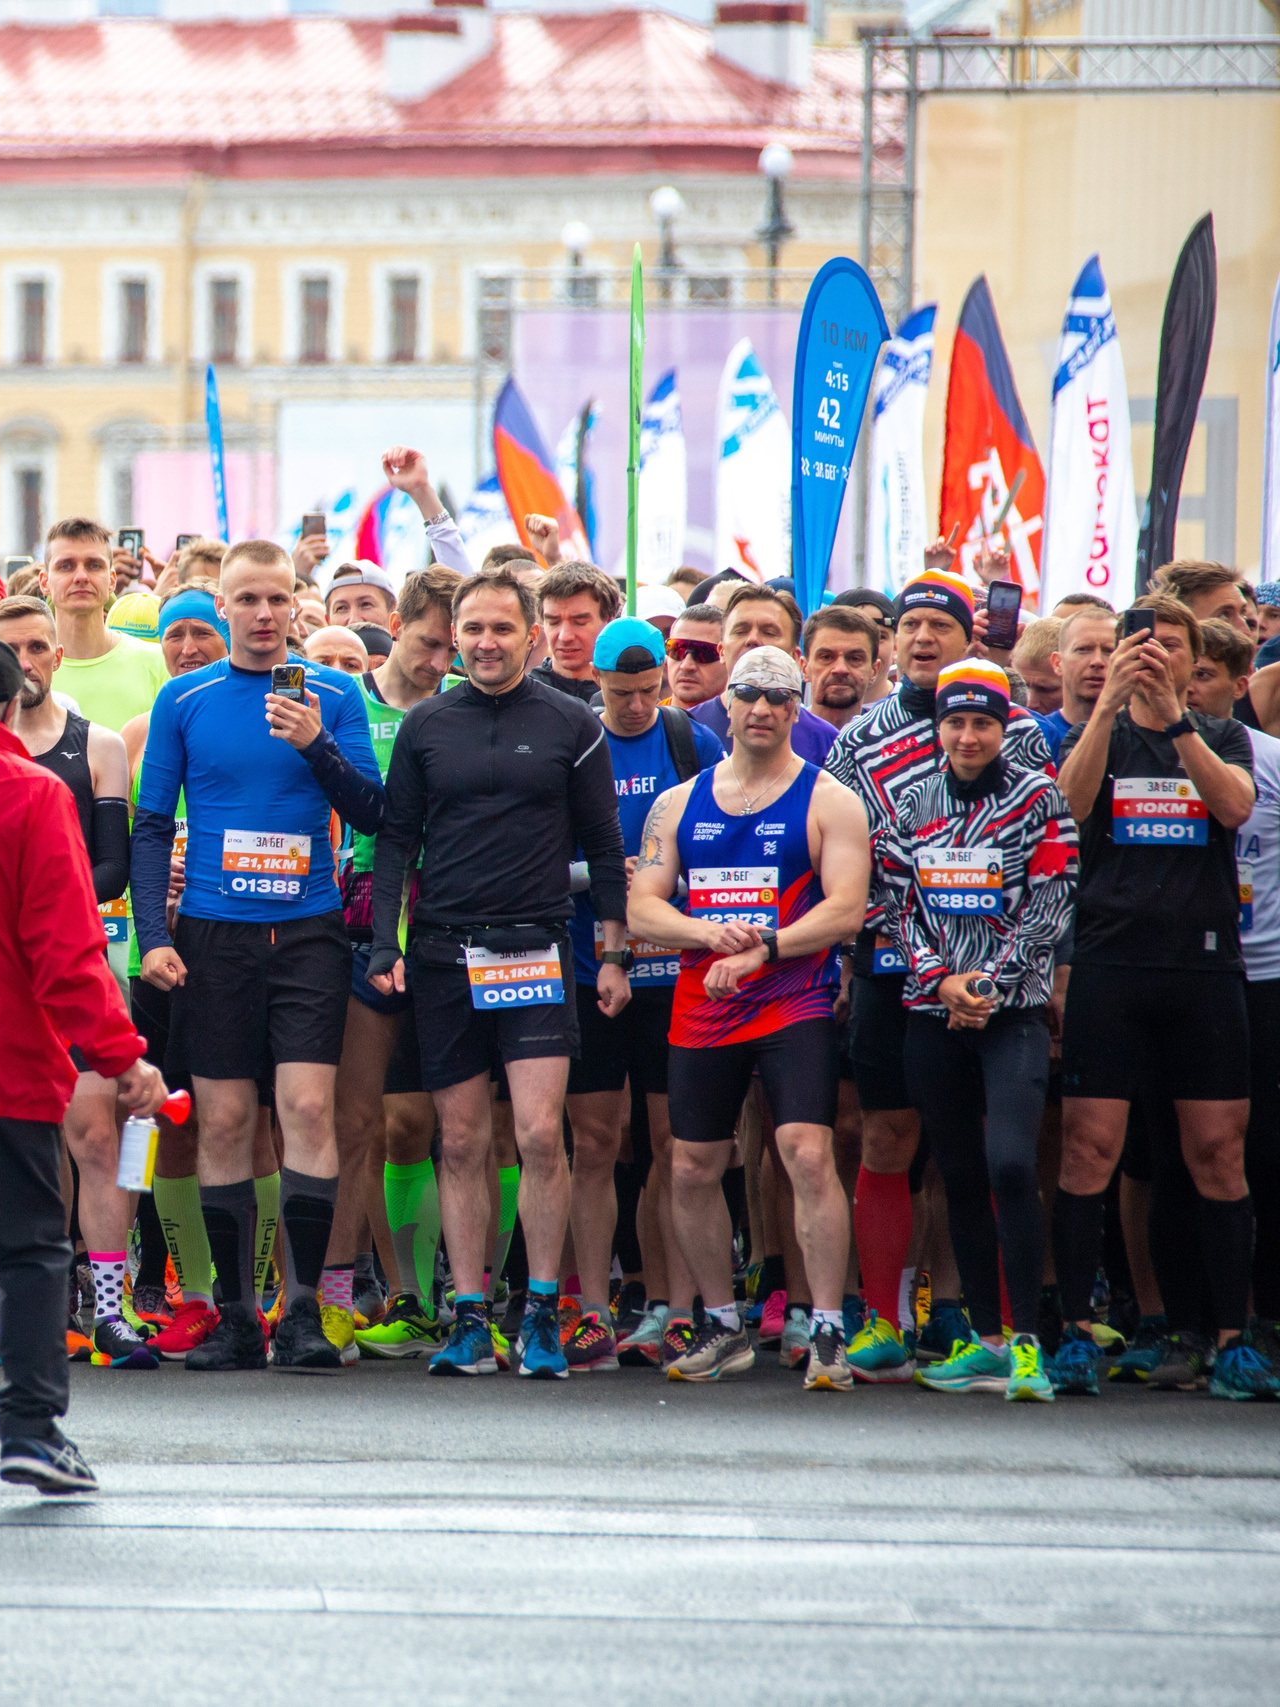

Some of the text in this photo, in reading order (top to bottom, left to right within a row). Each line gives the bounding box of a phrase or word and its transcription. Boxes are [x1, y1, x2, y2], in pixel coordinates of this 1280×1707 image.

[821, 320, 839, 347] 10
[825, 369, 849, 392] 4:15
[817, 397, 841, 430] 42
[814, 430, 845, 448] МИНУТЫ
[881, 736, 919, 758] HOKA
[632, 776, 657, 794] БЕГ
[1147, 781, 1179, 793] ЗА БЕГ
[1136, 802, 1189, 814] 10КМ
[1125, 823, 1195, 839] 14801
[256, 836, 286, 849] ЗА БЕГ
[237, 856, 298, 871] 21,1КМ
[945, 851, 973, 862] ЗА БЕГ
[720, 870, 749, 882] ЗА БЕГ
[930, 872, 988, 886] 21,1КМ
[231, 877, 301, 896] 01388
[710, 891, 760, 904] 10КМ
[927, 893, 997, 909] 02880
[484, 964, 547, 981] 21,1КМ
[483, 984, 553, 1004] 00011
